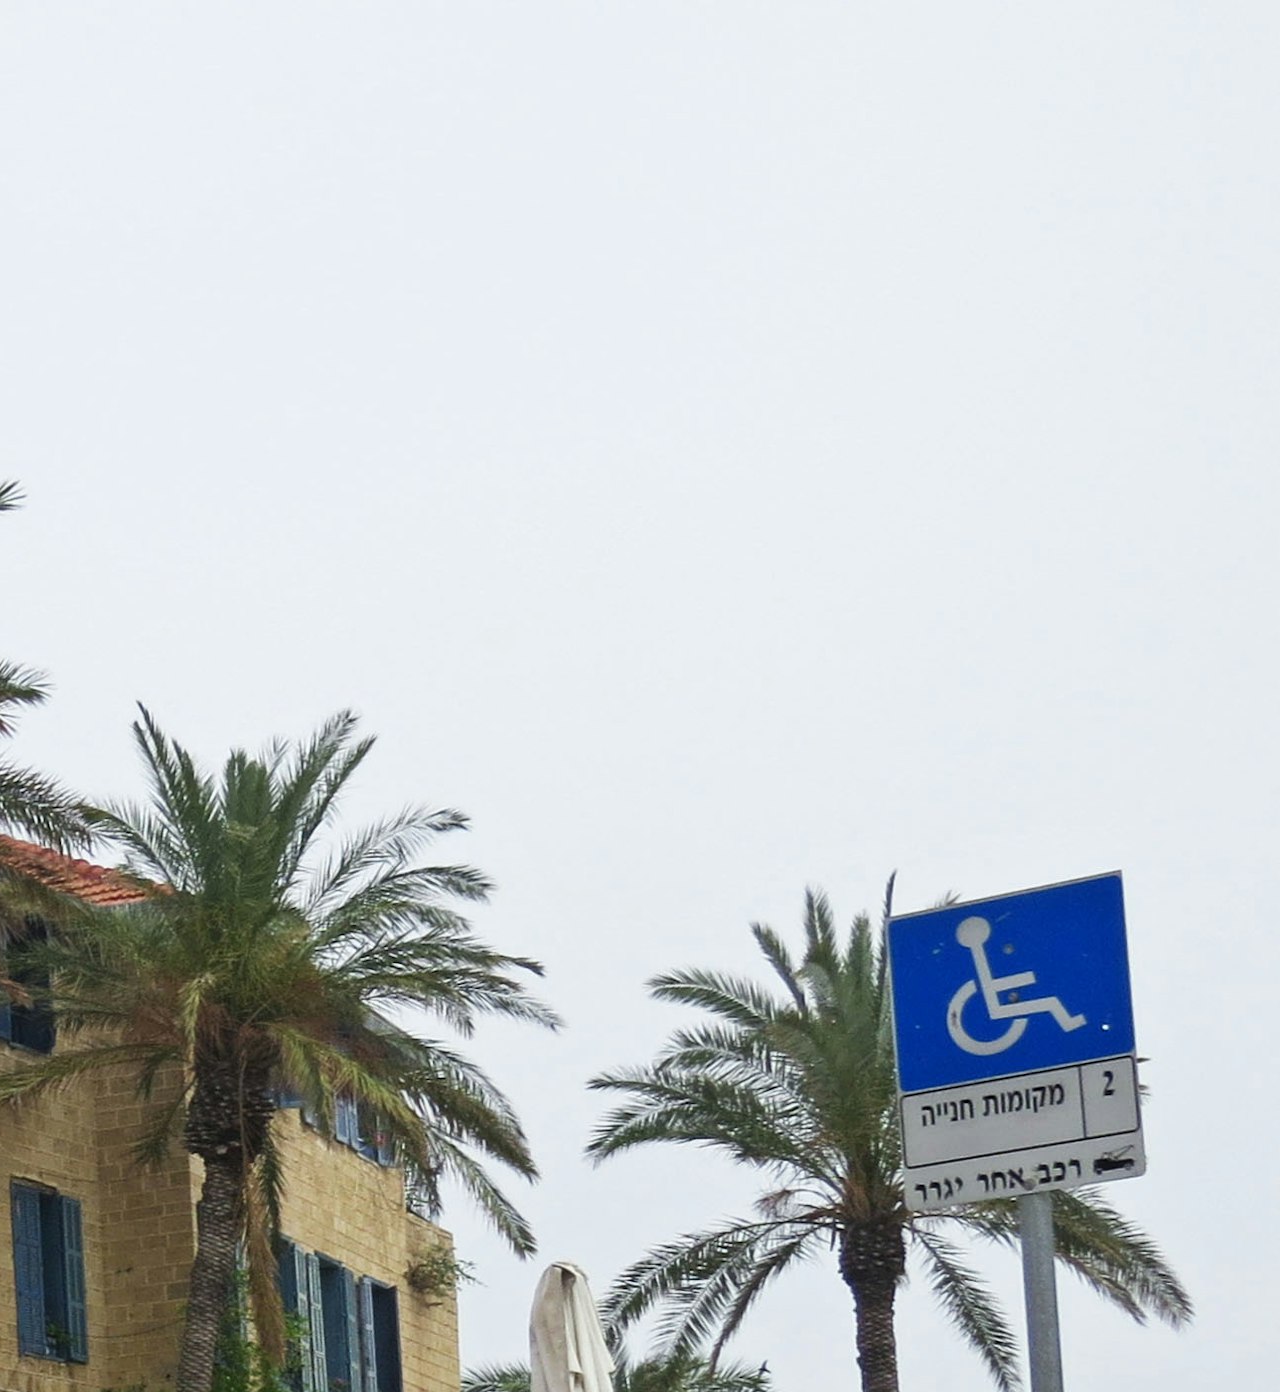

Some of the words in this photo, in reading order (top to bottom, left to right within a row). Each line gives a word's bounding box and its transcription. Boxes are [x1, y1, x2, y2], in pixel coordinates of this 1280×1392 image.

[1102, 1070, 1115, 1096] 2
[982, 1083, 1065, 1114] מקומות
[921, 1098, 975, 1127] חנייה
[977, 1167, 1030, 1193] אחר
[1037, 1159, 1082, 1185] רכב
[914, 1176, 963, 1202] יגרר
